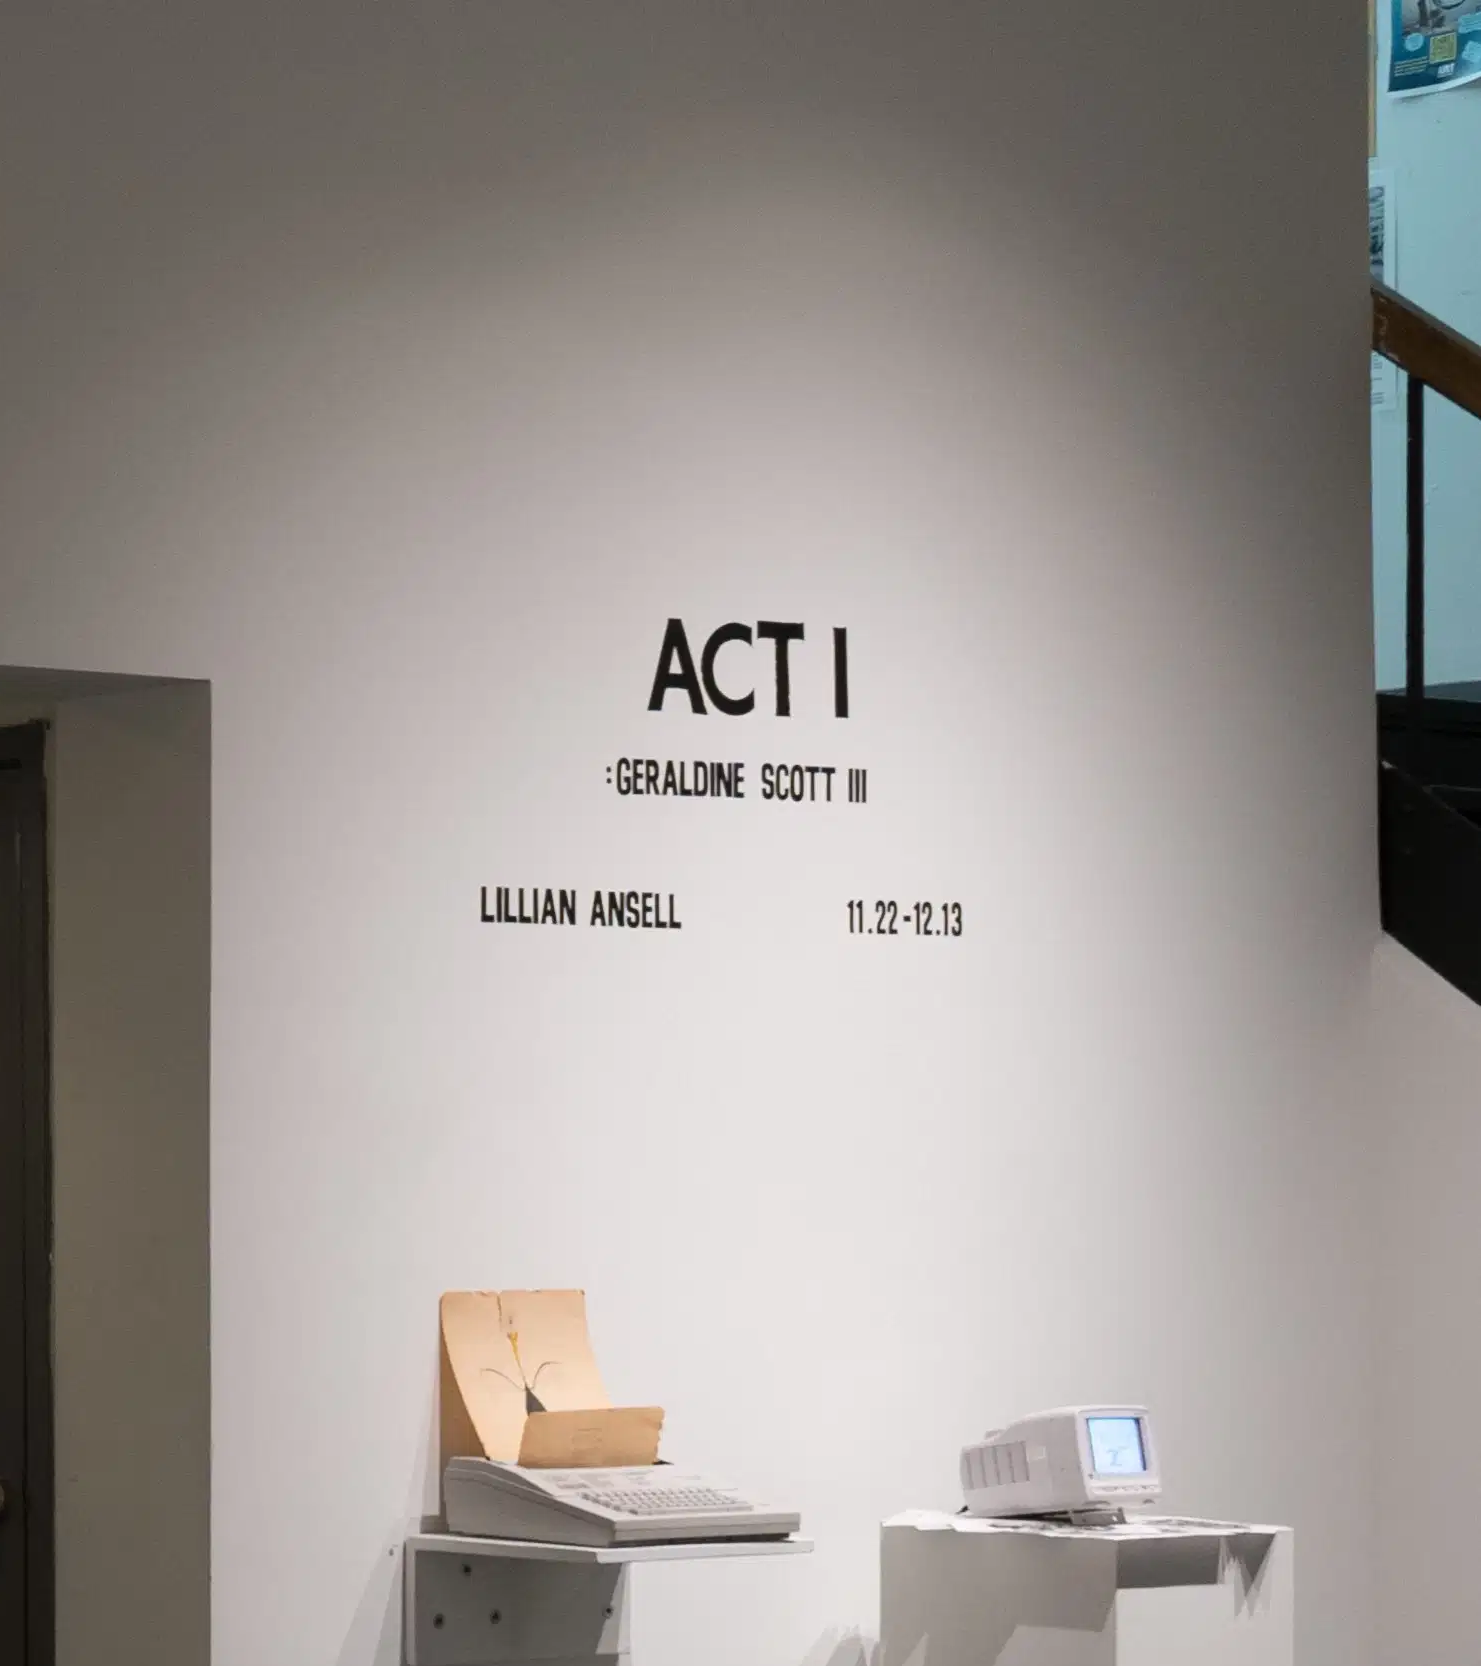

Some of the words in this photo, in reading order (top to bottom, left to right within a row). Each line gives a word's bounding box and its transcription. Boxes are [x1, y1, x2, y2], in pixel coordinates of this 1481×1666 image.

[647, 617, 805, 717] ACT
[832, 626, 849, 719] I
[761, 762, 836, 802] SCOTT
[848, 768, 867, 803] III
[480, 886, 576, 926] LILLIAN
[590, 890, 682, 929] ANSELL
